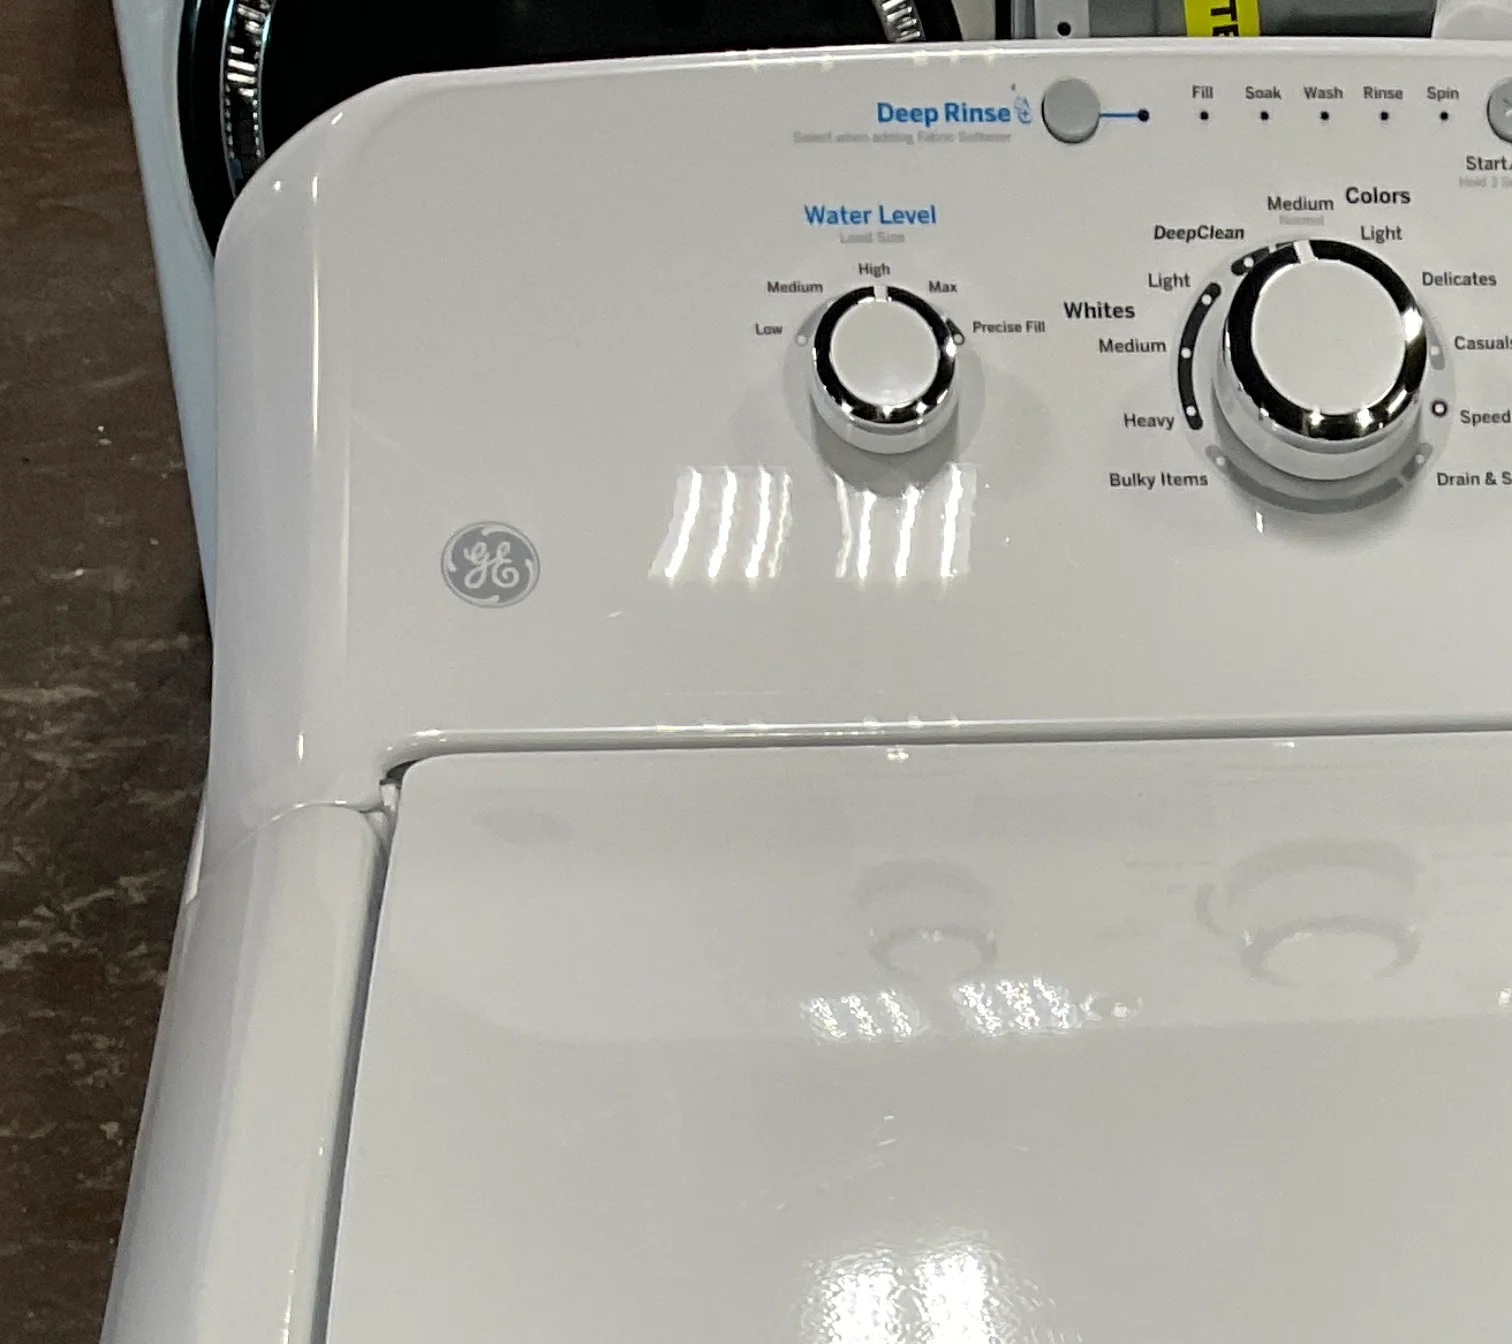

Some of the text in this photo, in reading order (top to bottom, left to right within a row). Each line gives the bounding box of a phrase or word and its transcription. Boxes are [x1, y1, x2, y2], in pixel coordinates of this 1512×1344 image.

[1192, 84, 1214, 99] Fill
[1245, 85, 1282, 100] Soak
[1303, 86, 1344, 100] Wash
[1363, 85, 1404, 100] Rinse
[1426, 85, 1460, 102] Spin
[877, 102, 1011, 128] Deep Rinse
[1267, 195, 1334, 212] Medium
[1345, 186, 1411, 205] Colors
[804, 204, 937, 225] Water Level
[1153, 224, 1245, 243] DeepClean
[1360, 225, 1403, 245] Light
[858, 262, 891, 279] High
[1421, 271, 1497, 287] Delicates
[766, 280, 824, 294] Medium
[928, 280, 958, 293] Max
[1148, 272, 1191, 292] Light
[1063, 301, 1136, 319] Whites
[754, 323, 783, 336] Low
[972, 320, 1046, 334] Precise Fill
[1098, 338, 1167, 354] Medium
[1123, 413, 1175, 431] Heavy
[1459, 409, 1512, 427] Speed
[1109, 472, 1209, 490] Bulky Items
[1436, 472, 1481, 487] Drain
[1484, 471, 1497, 486] &
